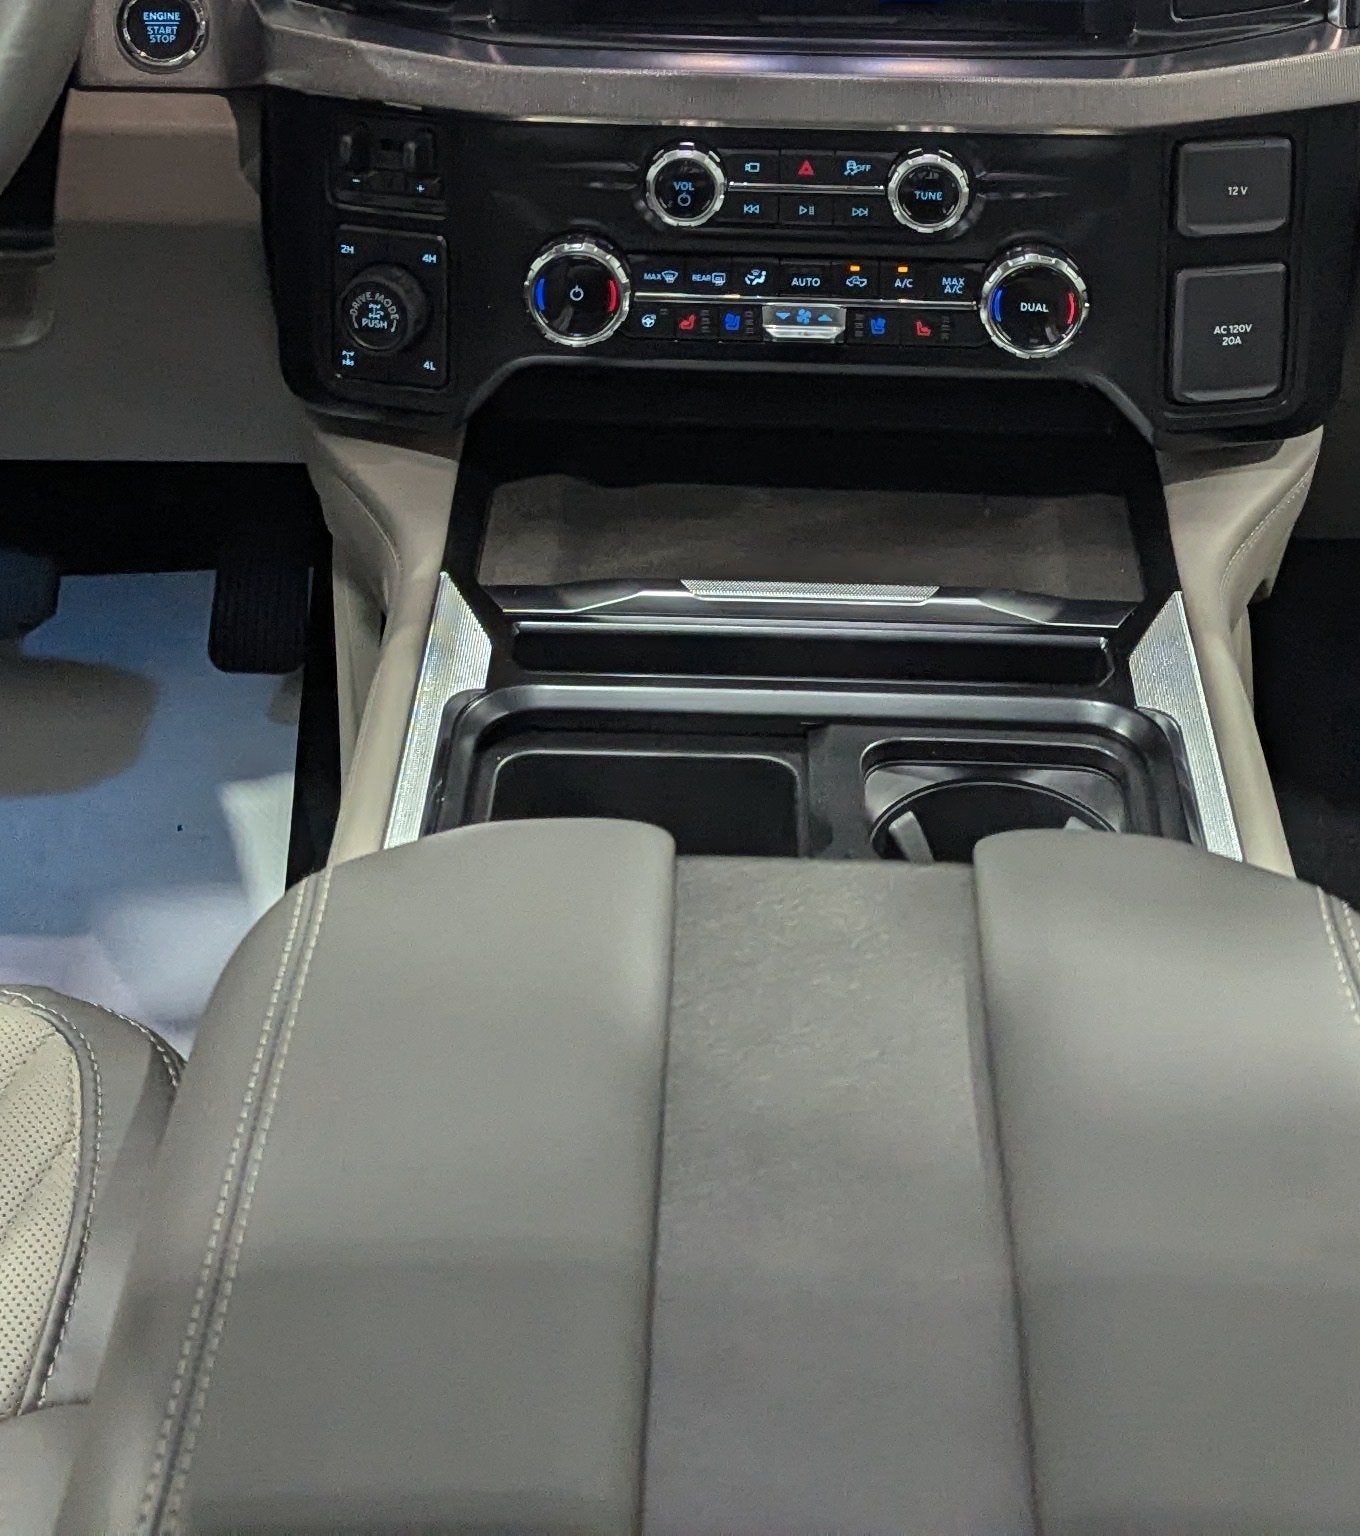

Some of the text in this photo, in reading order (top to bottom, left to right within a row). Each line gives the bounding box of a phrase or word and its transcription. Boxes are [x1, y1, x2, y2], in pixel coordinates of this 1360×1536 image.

[143, 12, 181, 21] ENGINE
[147, 26, 178, 35] START
[149, 34, 176, 43] STOP
[857, 165, 872, 173] OFF
[673, 181, 695, 192] VOL
[914, 191, 943, 201] TUNE
[340, 245, 355, 254] 2H
[422, 254, 437, 264] 4H
[643, 272, 662, 281] MAX
[692, 273, 712, 282] REAR
[942, 276, 966, 286] MAX
[791, 277, 821, 287] AUTO
[894, 278, 914, 288] A/C
[944, 285, 964, 294] A/C
[349, 291, 400, 320] DRIVE MODE
[1020, 302, 1050, 313] DUAL
[361, 317, 388, 330] PUSH
[1213, 323, 1253, 335] AC 120V
[1221, 335, 1243, 346] 20A
[423, 361, 437, 371] 4L
